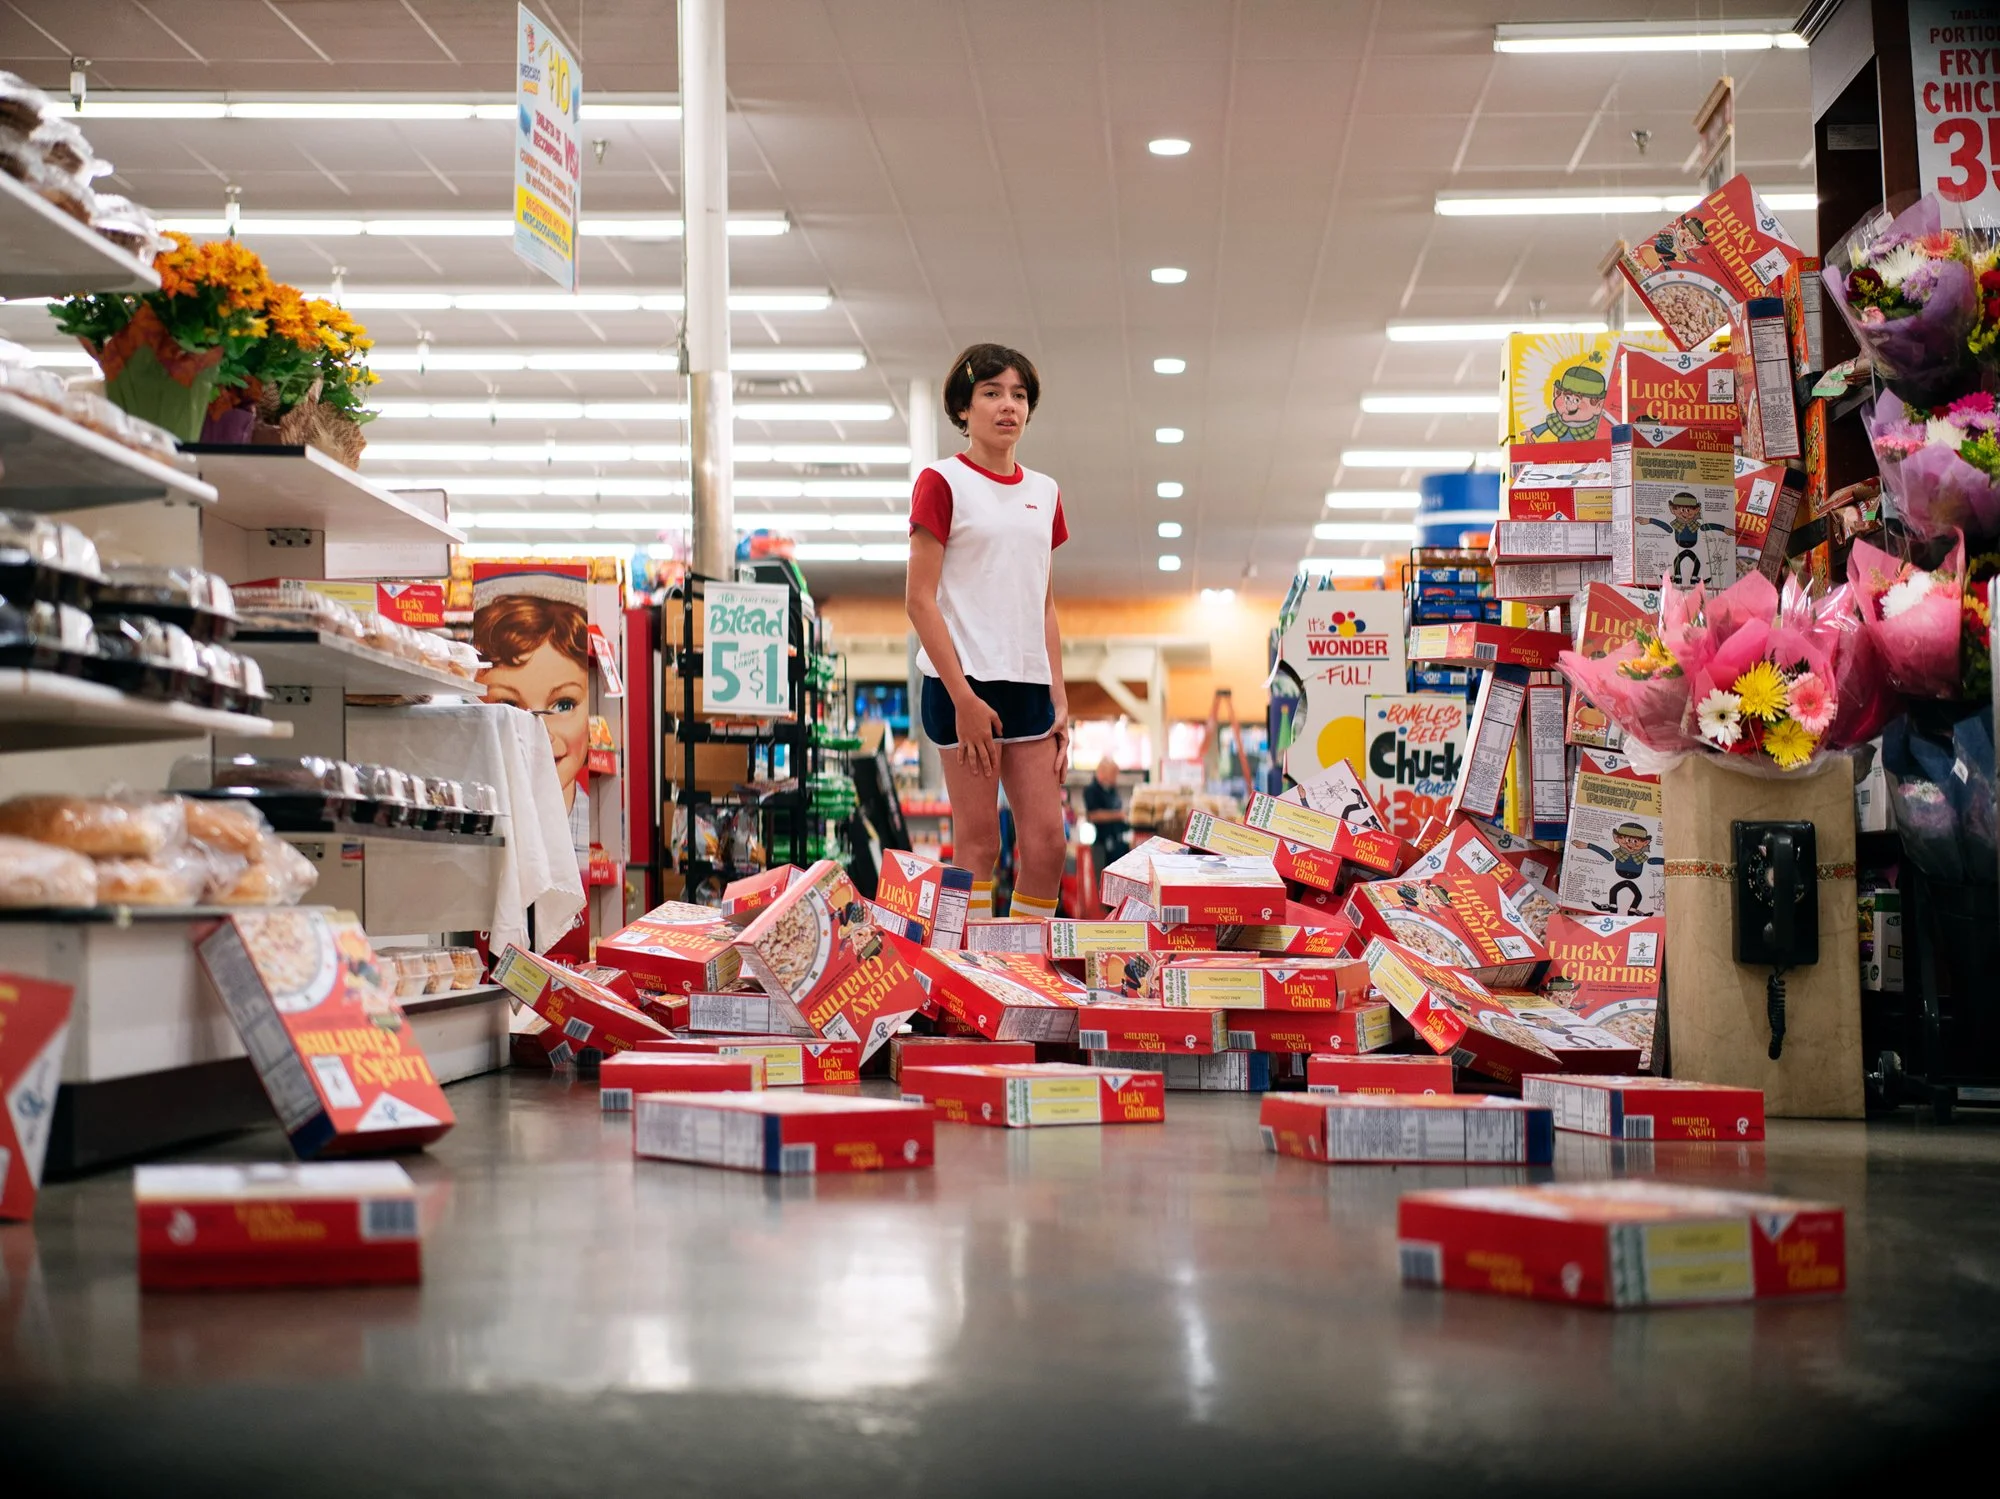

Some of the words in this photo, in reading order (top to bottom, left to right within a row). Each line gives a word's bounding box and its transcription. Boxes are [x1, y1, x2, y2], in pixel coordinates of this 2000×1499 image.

[1933, 118, 2000, 203] 3
[1707, 191, 1761, 255] Lucky
[1702, 218, 1766, 298] Charms
[1631, 379, 1702, 403] Lucky
[1646, 400, 1739, 420] Charms
[1689, 429, 1719, 444] Lucky
[1696, 441, 1735, 452] Charms
[1636, 456, 1697, 470] LEPRECHAUN
[1514, 492, 1550, 500] Charms
[1528, 501, 1556, 512] Lucky
[396, 598, 424, 612] Lucky
[402, 610, 440, 623] Charms
[710, 604, 784, 637] Bread
[1308, 618, 1326, 633] It's
[1308, 639, 1388, 656] WONDER
[1511, 647, 1539, 657] Charms
[1520, 656, 1542, 665] Lucky
[712, 641, 740, 703] 5
[1386, 703, 1463, 727] BONELESS
[1406, 723, 1450, 745] BEEF
[1369, 731, 1463, 785] Chuck
[1581, 780, 1652, 802] LEPRECHAUN
[1614, 779, 1630, 787] Lucky
[1631, 782, 1652, 790] Charms
[1352, 836, 1381, 854] Lucky
[1291, 856, 1320, 874] Lucky
[1355, 850, 1389, 868] Charms
[1295, 868, 1330, 887] Charms
[879, 878, 917, 913] Lucky
[1204, 907, 1237, 915] Charms
[1453, 873, 1505, 934] Lucky
[1218, 913, 1243, 923] Lucky
[1448, 891, 1506, 965] Charms
[1167, 934, 1196, 947] Lucky
[1304, 942, 1336, 953] Charms
[1305, 936, 1328, 947] Lucky
[1549, 940, 1622, 965] Lucky
[1561, 962, 1657, 983] Charms
[644, 979, 668, 991] Lucky
[809, 956, 884, 1029] Charms
[853, 960, 911, 1023] Lucky
[1284, 983, 1315, 996] Lucky
[1291, 995, 1331, 1008] Charms
[1426, 1011, 1447, 1036] Lucky
[296, 1027, 401, 1057] Charms
[1124, 1032, 1160, 1041] Charms
[1270, 1033, 1306, 1041] Charms
[1422, 1024, 1446, 1050] Charms
[1137, 1039, 1165, 1051] Lucky
[1285, 1040, 1312, 1051] Lucky
[352, 1052, 434, 1089] Lucky
[818, 1056, 842, 1070] Lucky
[823, 1068, 856, 1081] Charms
[1117, 1090, 1145, 1105] Lucky
[1124, 1104, 1160, 1120] Charms
[1672, 1116, 1710, 1126] Charms
[1687, 1126, 1716, 1138] Lucky
